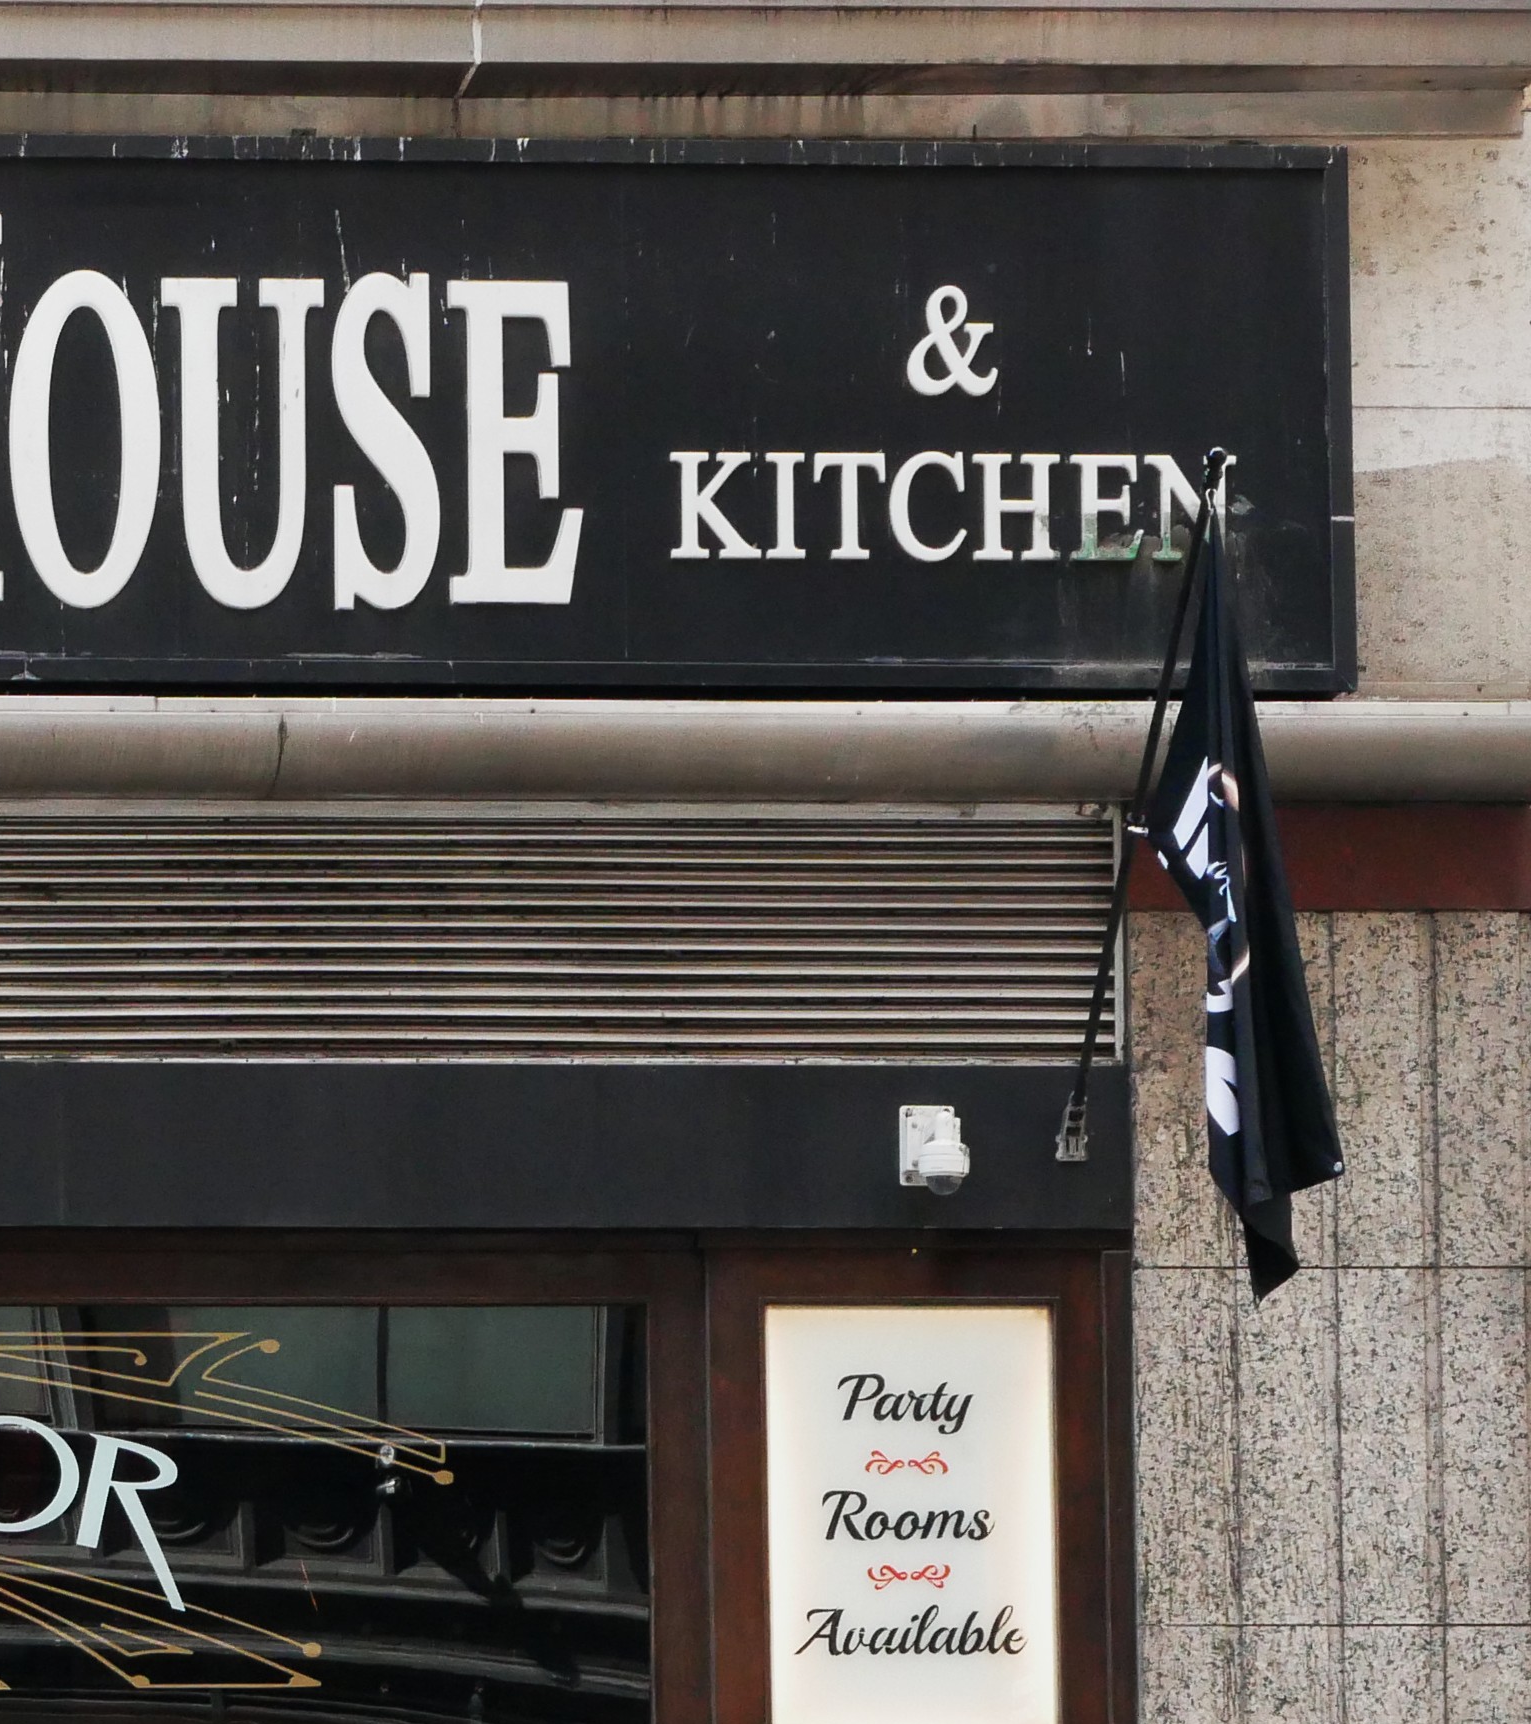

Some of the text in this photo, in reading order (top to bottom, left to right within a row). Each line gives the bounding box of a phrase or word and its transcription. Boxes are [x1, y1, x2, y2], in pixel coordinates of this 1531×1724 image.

[906, 285, 999, 396] &
[669, 451, 1237, 562] KITCHEN
[837, 1373, 974, 1434] Party
[821, 1490, 996, 1542] Rooms
[794, 1605, 1028, 1656] Available
